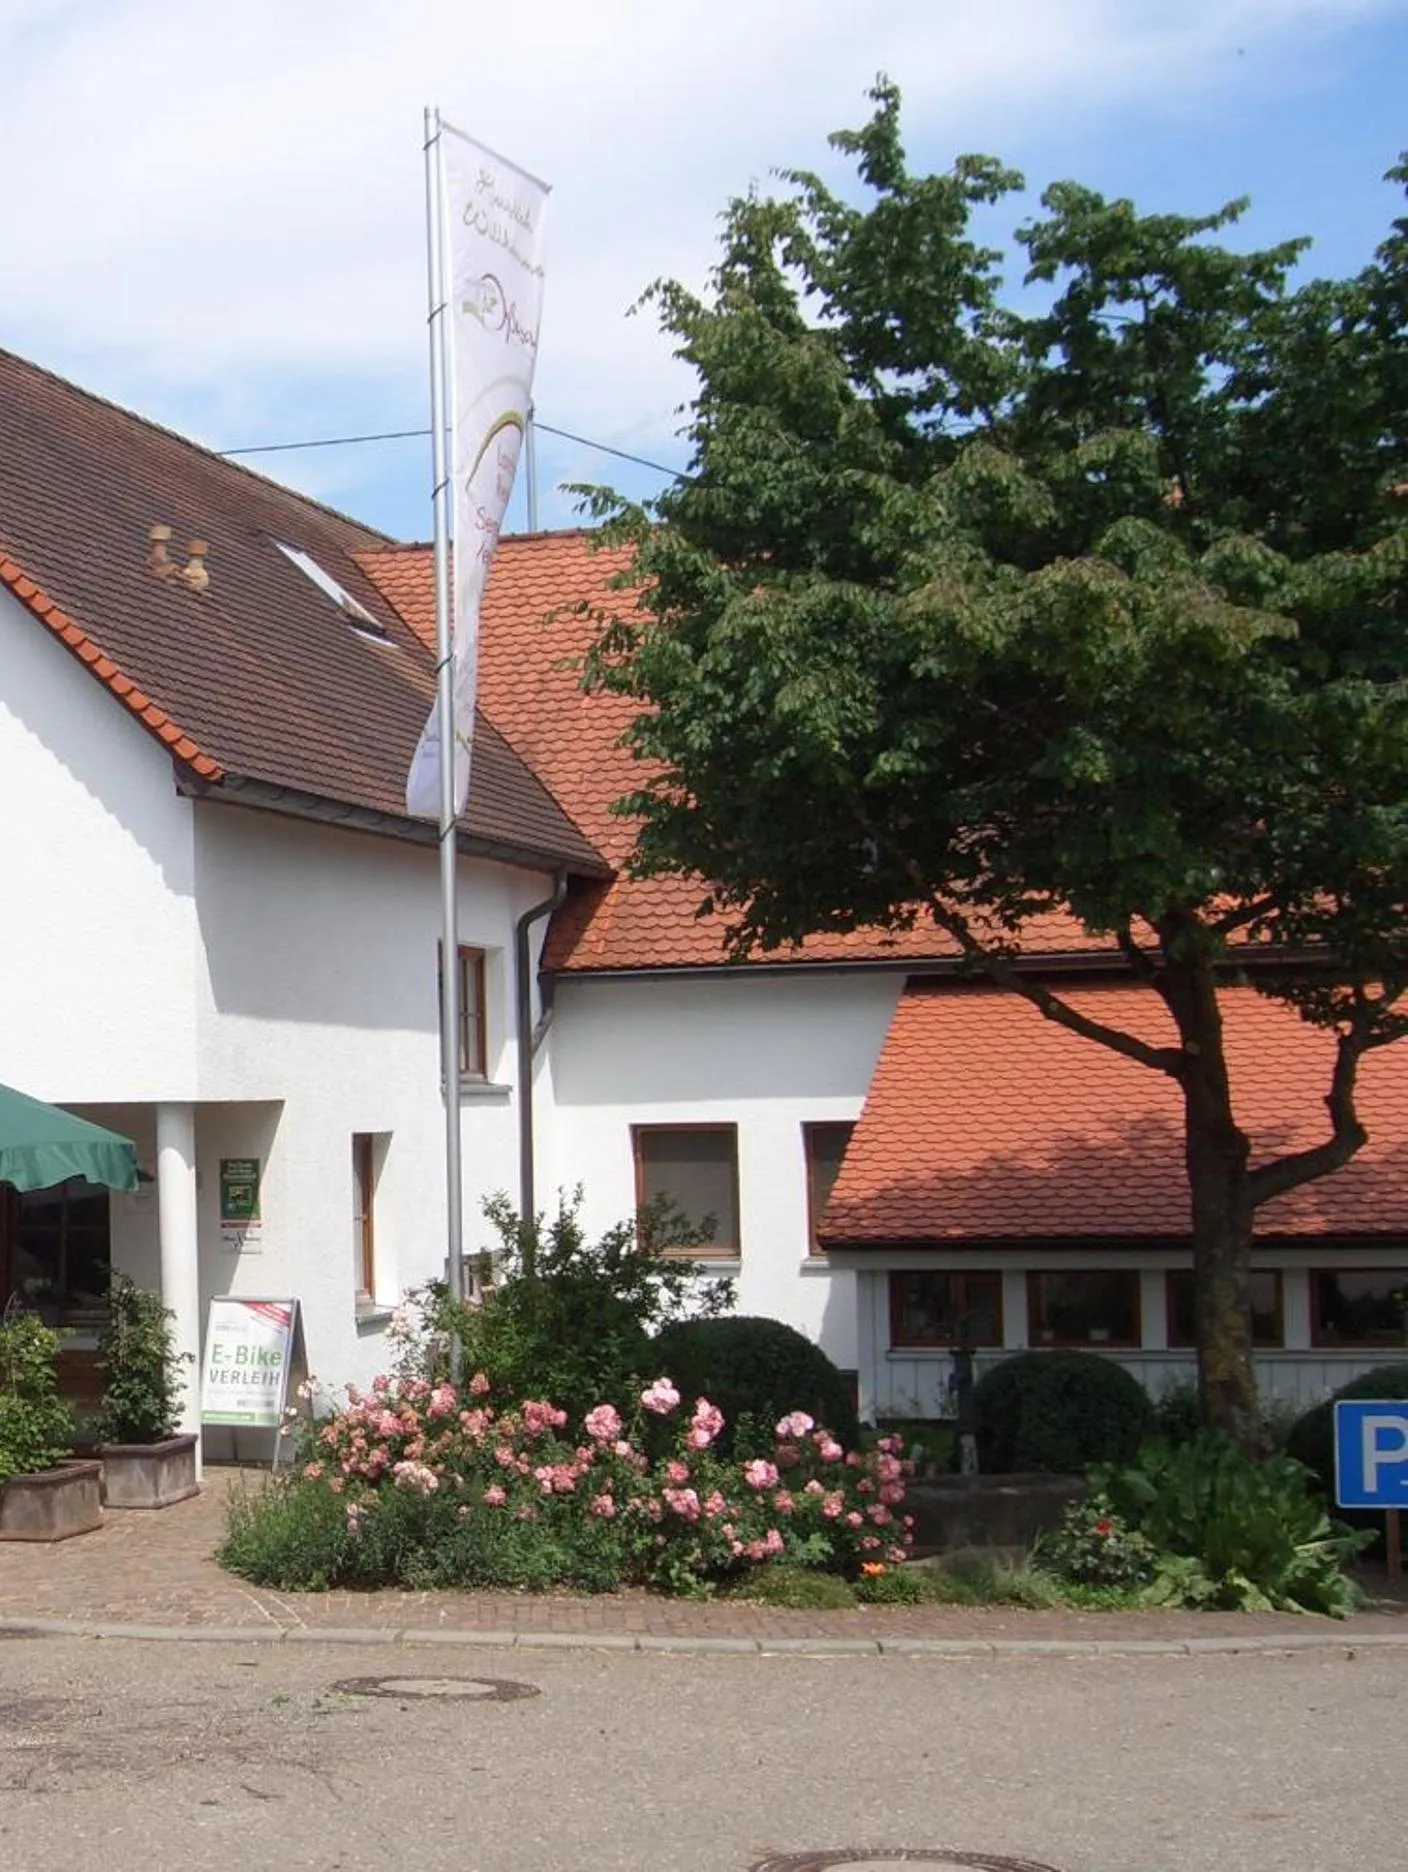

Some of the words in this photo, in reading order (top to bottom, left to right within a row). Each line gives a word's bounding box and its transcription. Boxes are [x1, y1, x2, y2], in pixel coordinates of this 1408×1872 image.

[212, 1343, 282, 1366] E-Bike
[209, 1369, 281, 1386] VERLEIH
[1362, 1415, 1408, 1492] P
